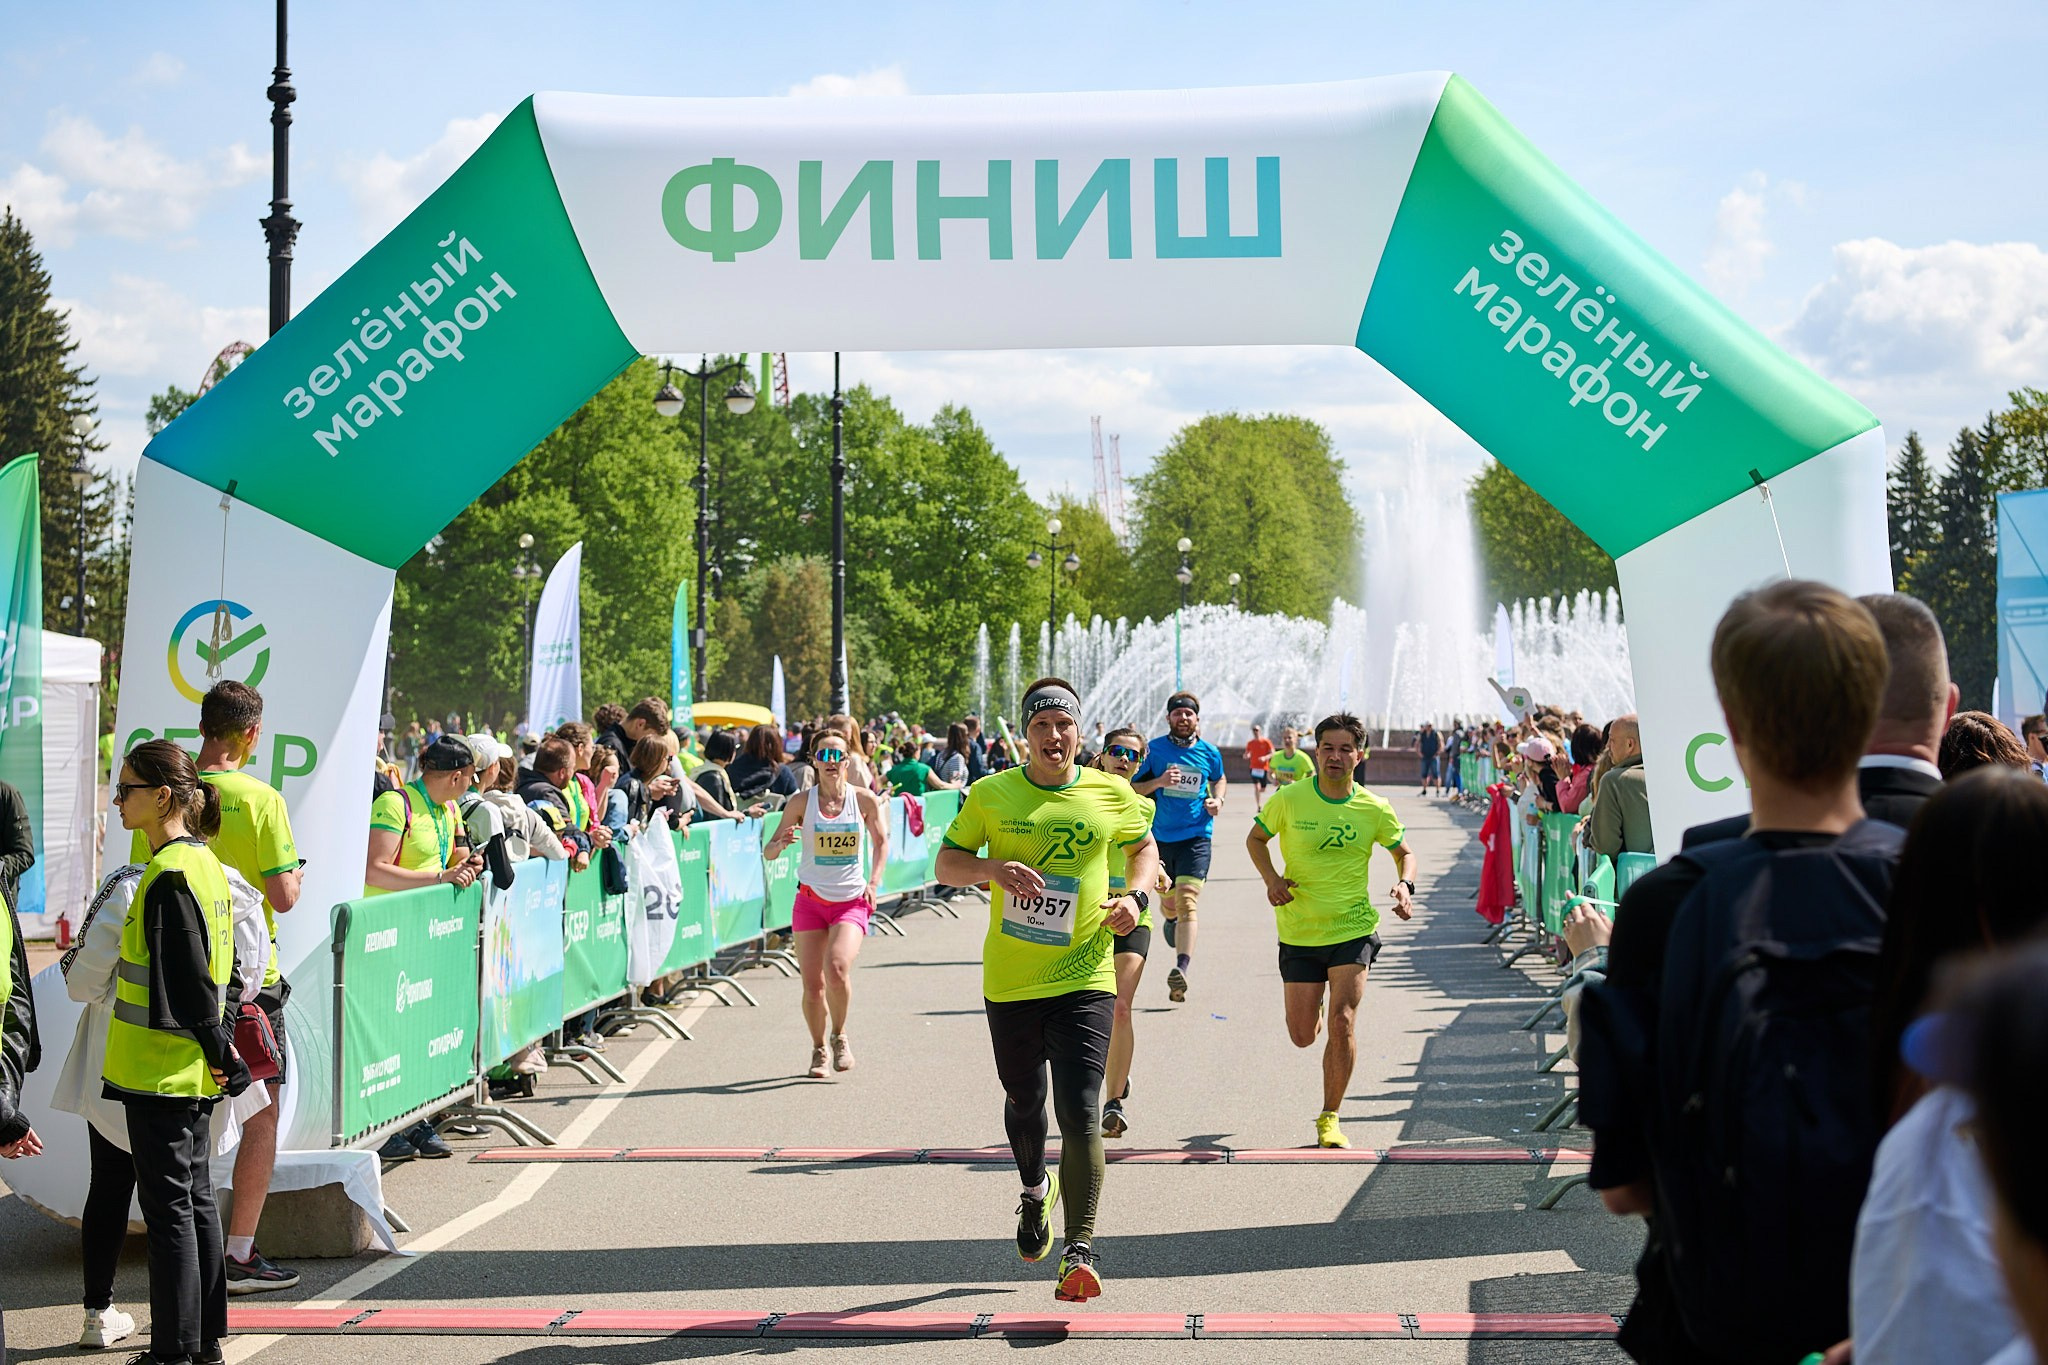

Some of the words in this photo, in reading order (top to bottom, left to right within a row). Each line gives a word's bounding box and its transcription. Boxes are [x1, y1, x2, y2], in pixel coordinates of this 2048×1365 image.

[661, 156, 1282, 262] ФИНИШ
[282, 230, 484, 419] зелёный
[1488, 229, 1709, 413] зелёный
[312, 271, 517, 458] марафон
[1453, 266, 1668, 452] марафон
[1033, 698, 1073, 710] TERREX
[1000, 818, 1035, 828] зелёный
[819, 836, 856, 848] 11243
[1012, 895, 1071, 918] 10957
[365, 927, 398, 953] REDMOND
[569, 910, 589, 942] СБЕР
